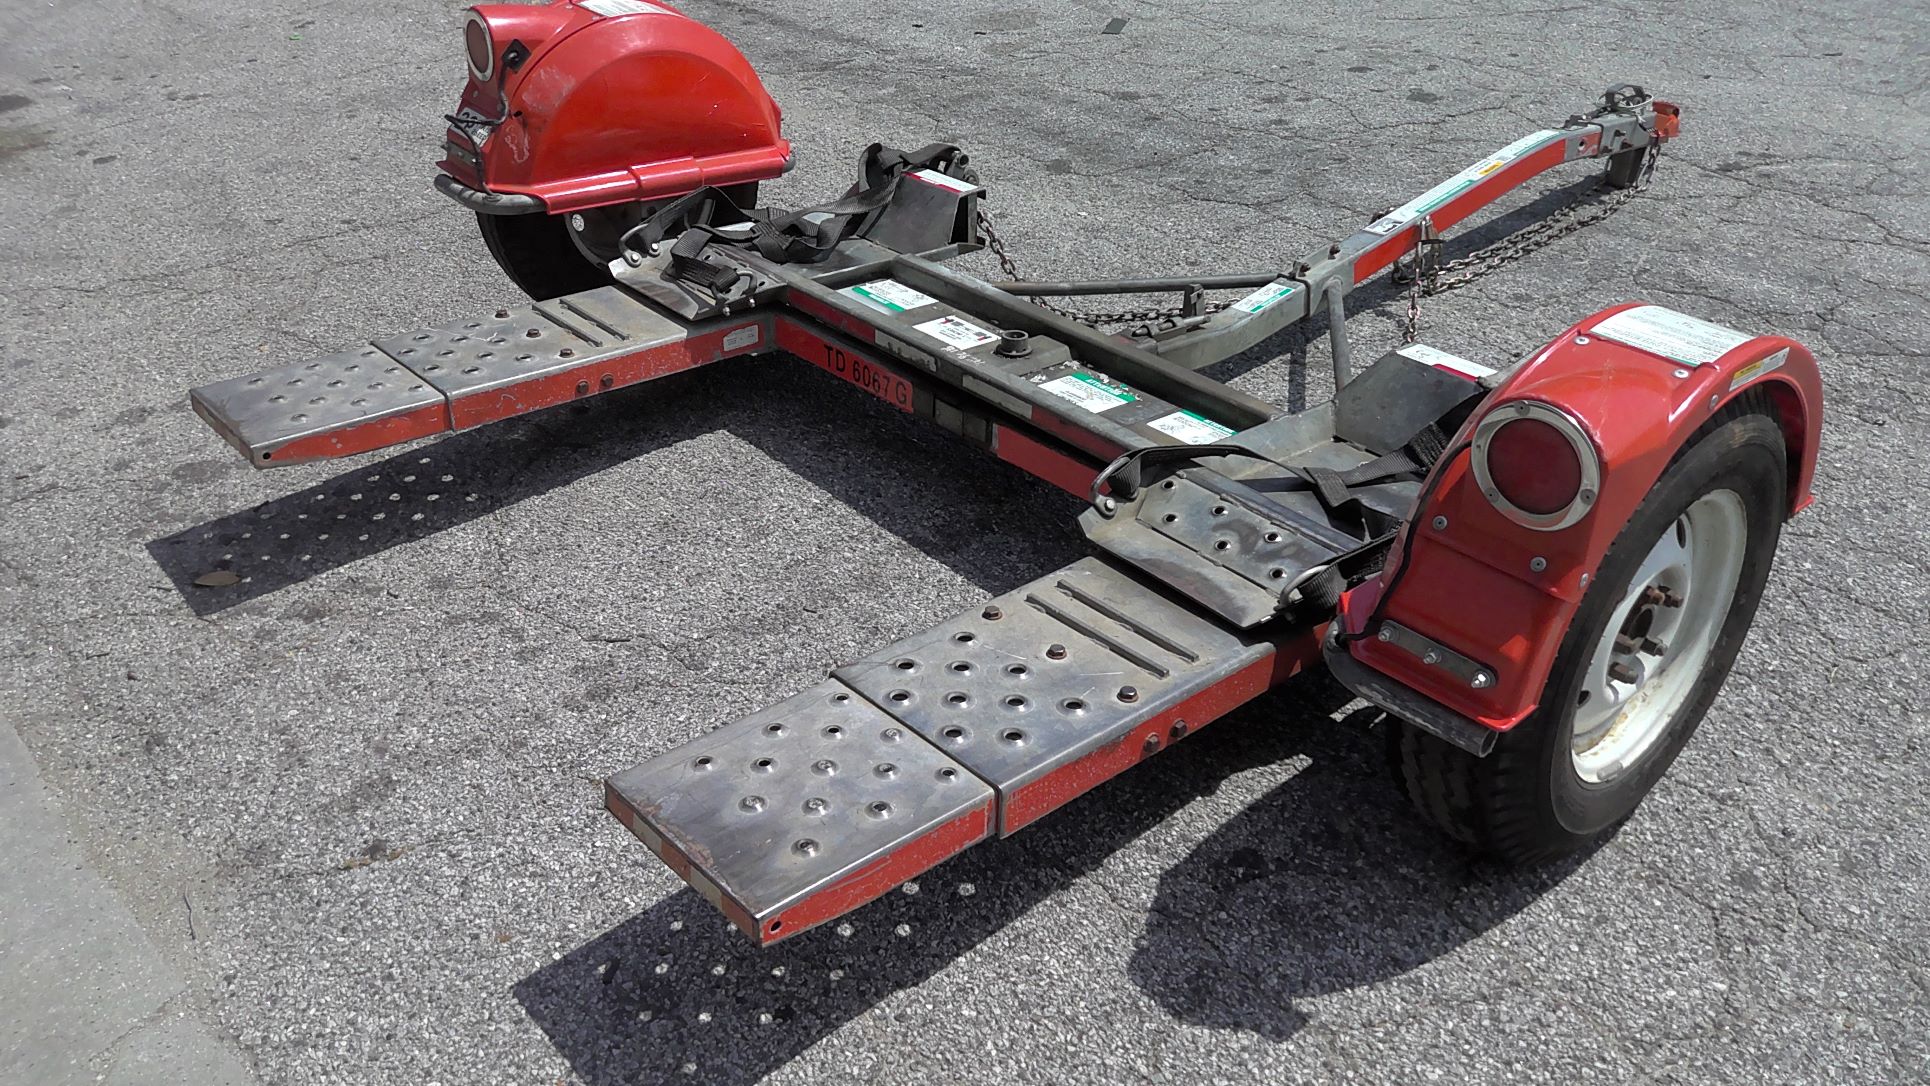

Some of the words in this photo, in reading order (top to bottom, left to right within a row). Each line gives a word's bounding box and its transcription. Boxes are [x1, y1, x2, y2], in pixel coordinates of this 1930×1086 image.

[824, 344, 846, 372] TD
[852, 361, 890, 394] 6067
[895, 382, 907, 404] G
